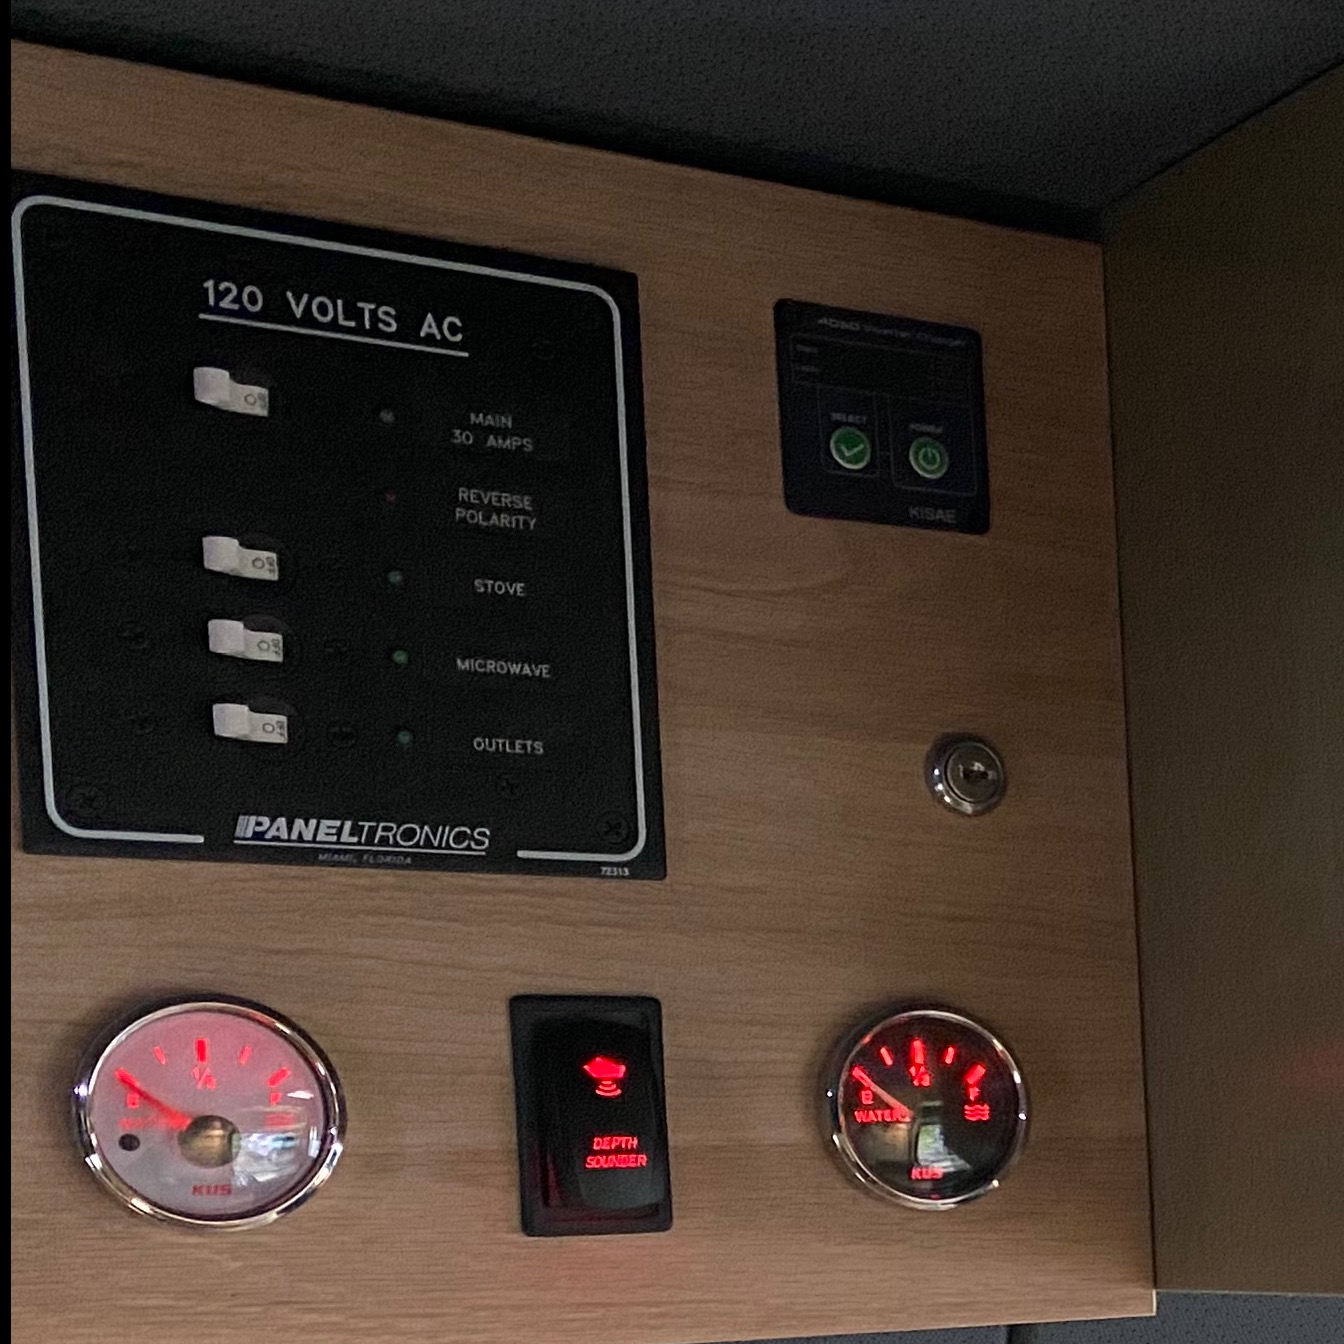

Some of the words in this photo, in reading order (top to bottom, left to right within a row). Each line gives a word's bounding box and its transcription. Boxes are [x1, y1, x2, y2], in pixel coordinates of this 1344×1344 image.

[202, 279, 264, 312] 120
[286, 291, 398, 333] VOLTS
[420, 312, 464, 343] AC
[470, 412, 513, 429] MAIN
[451, 429, 474, 445] 30
[486, 434, 534, 452] AMPS
[458, 487, 534, 511] REVERSE
[455, 507, 537, 530] POLARITY
[908, 505, 957, 525] KISAE
[474, 578, 526, 597] STOVE
[457, 658, 552, 678] MICROWAVE
[473, 736, 545, 755] OUTLETS
[235, 814, 491, 851] PANELTRONICS
[593, 1136, 639, 1151] DEPTH
[585, 1153, 648, 1169] SOUNDER
[192, 1184, 232, 1196] KUS
